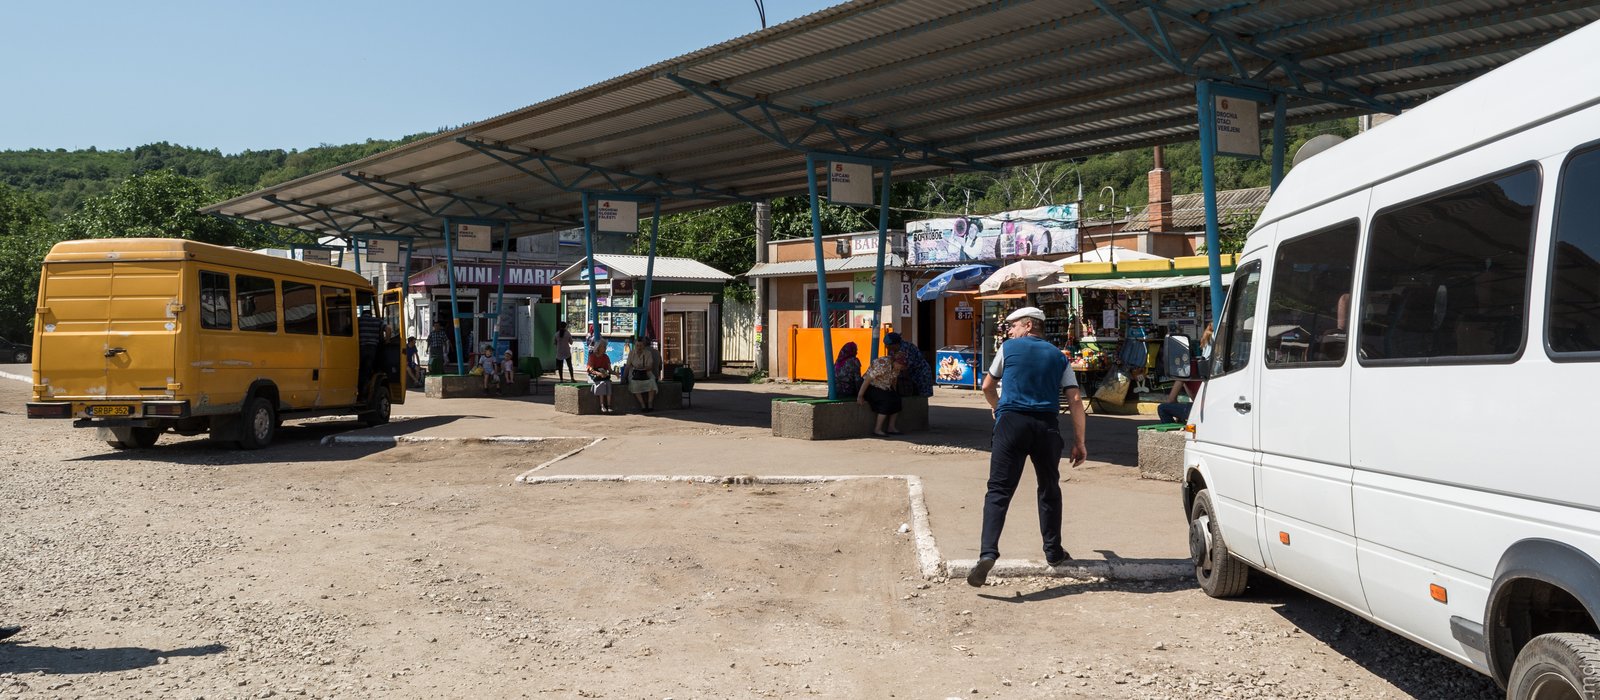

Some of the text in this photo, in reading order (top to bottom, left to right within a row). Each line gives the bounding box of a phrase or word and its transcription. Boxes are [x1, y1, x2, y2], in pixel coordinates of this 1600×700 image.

[1221, 99, 1229, 110] 6
[835, 164, 843, 172] 5
[855, 237, 879, 250] BAR
[453, 266, 561, 285] MINI MARK
[902, 283, 910, 314] BAR
[114, 407, 128, 415] 352
